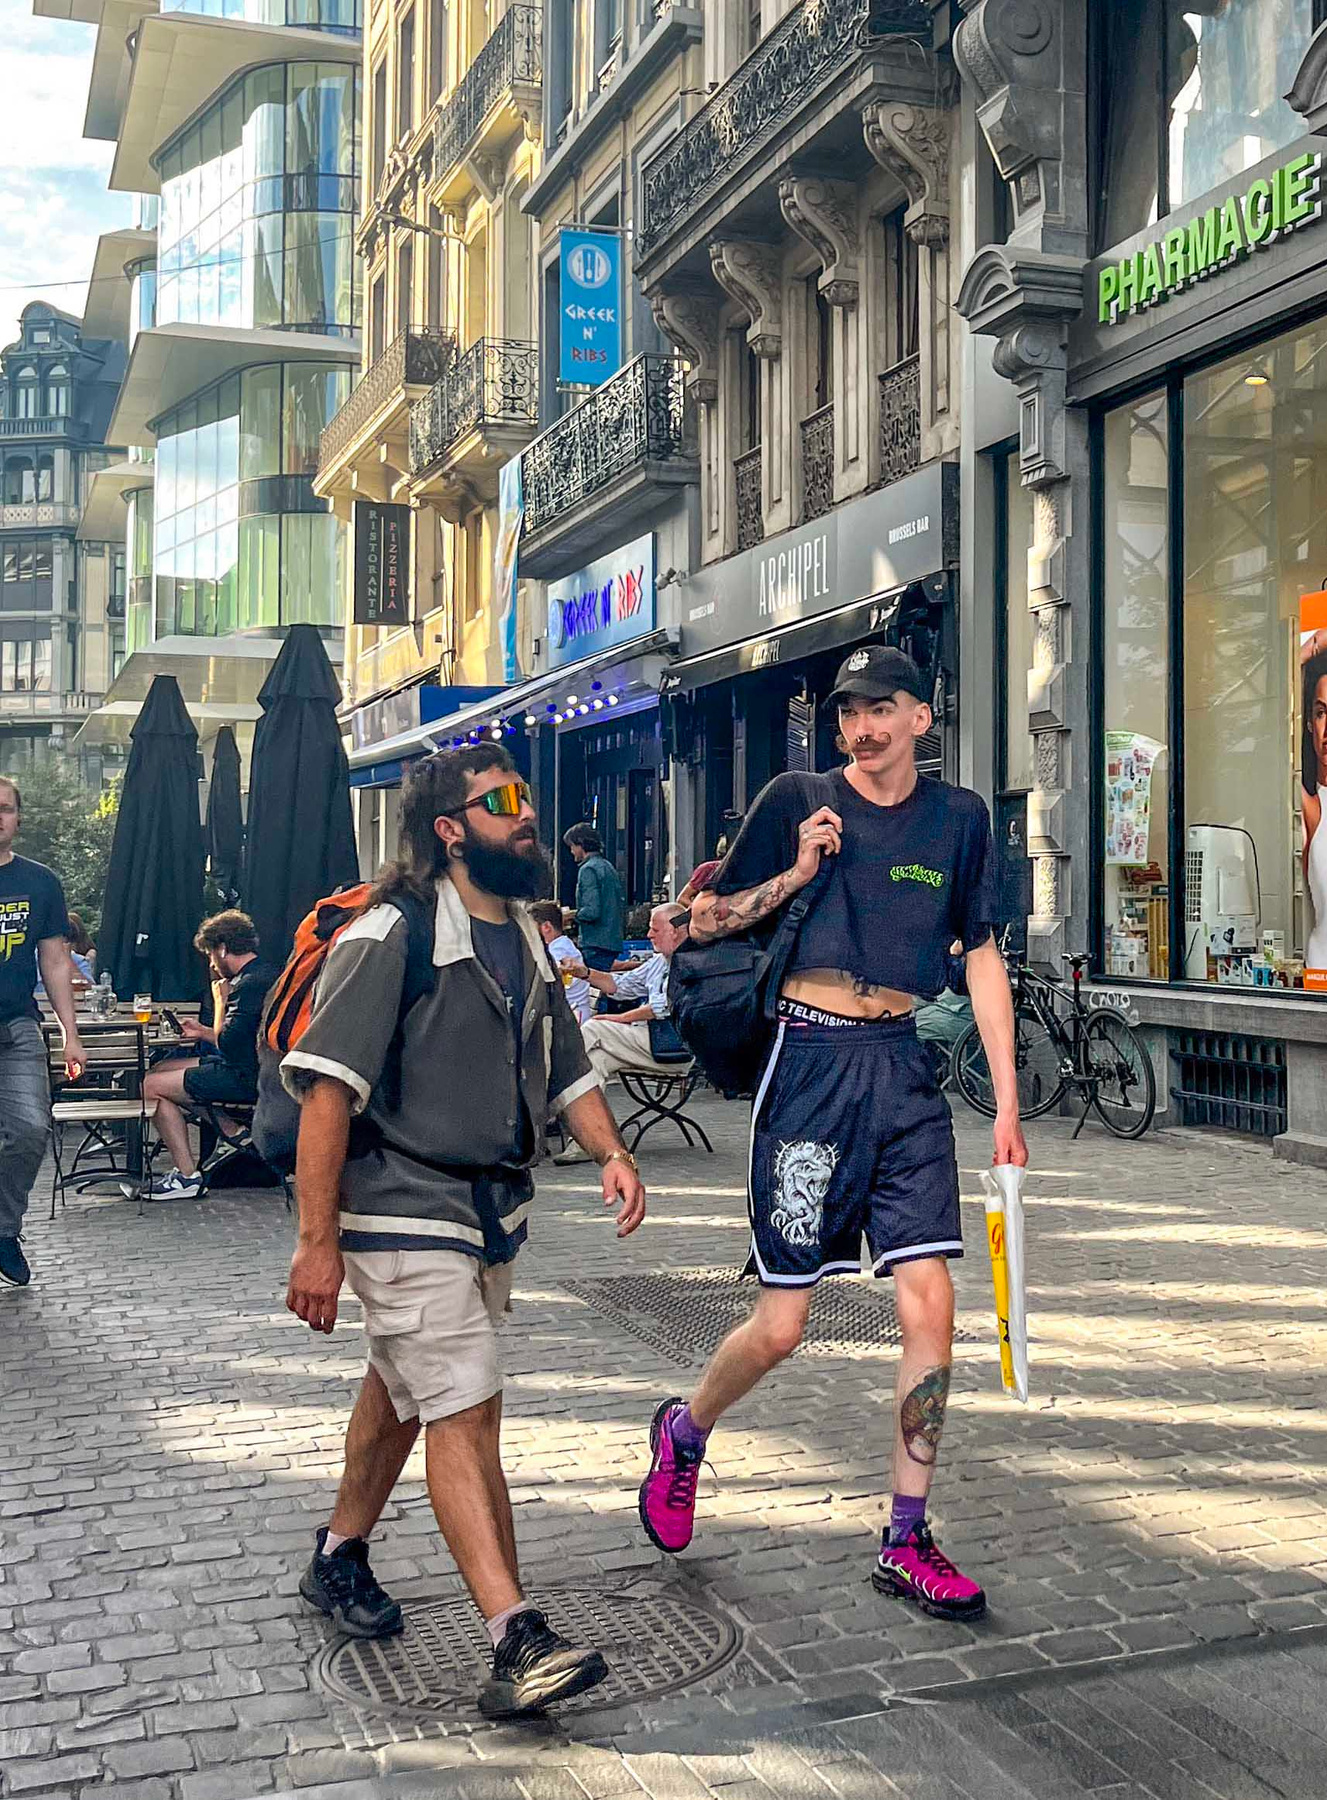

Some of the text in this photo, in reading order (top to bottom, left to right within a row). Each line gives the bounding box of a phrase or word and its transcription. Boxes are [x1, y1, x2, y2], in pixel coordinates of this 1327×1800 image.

[1098, 152, 1322, 325] PHARMACIE
[565, 304, 615, 323] GREEK
[582, 326, 598, 341] N'
[571, 347, 608, 364] RIBS
[368, 510, 378, 618] RISTORANTE
[387, 522, 397, 609] PIZZERIA
[758, 534, 830, 617] ARCHIPEL
